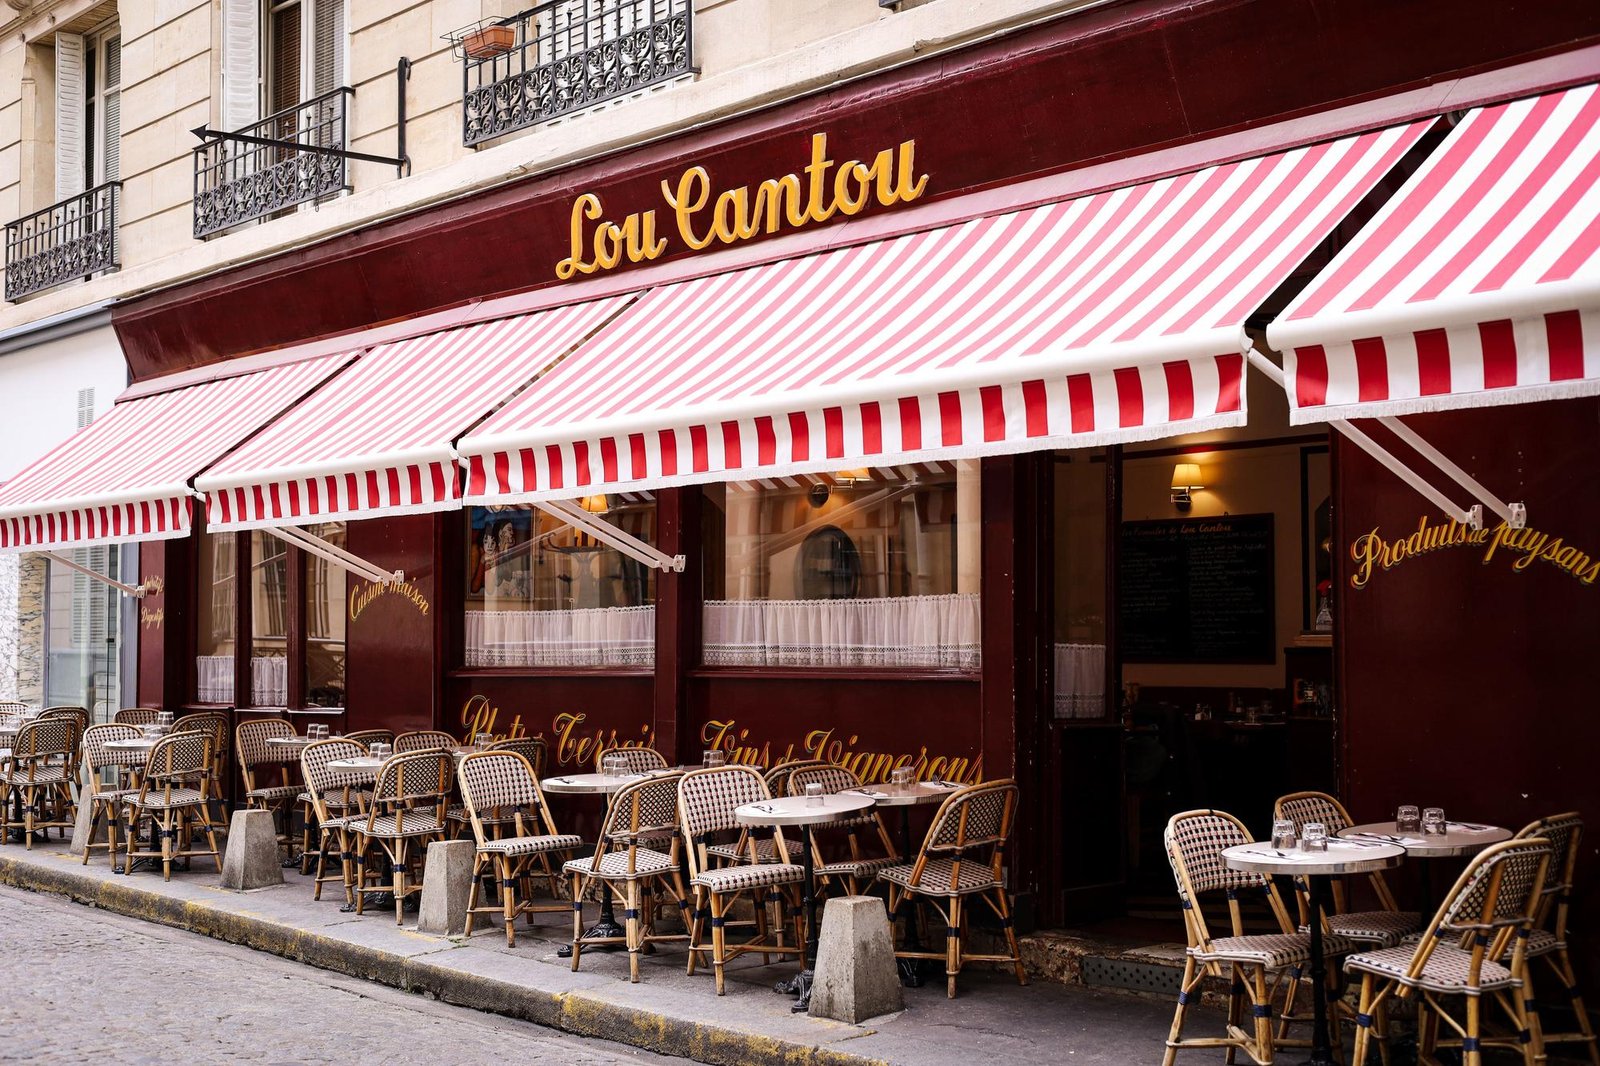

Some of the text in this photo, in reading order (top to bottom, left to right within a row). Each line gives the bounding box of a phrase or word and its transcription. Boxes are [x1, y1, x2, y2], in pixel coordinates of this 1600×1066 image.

[555, 132, 930, 281] Lou Cantou
[1482, 519, 1600, 585] paysans
[701, 719, 983, 786] Vins d Vignerons
